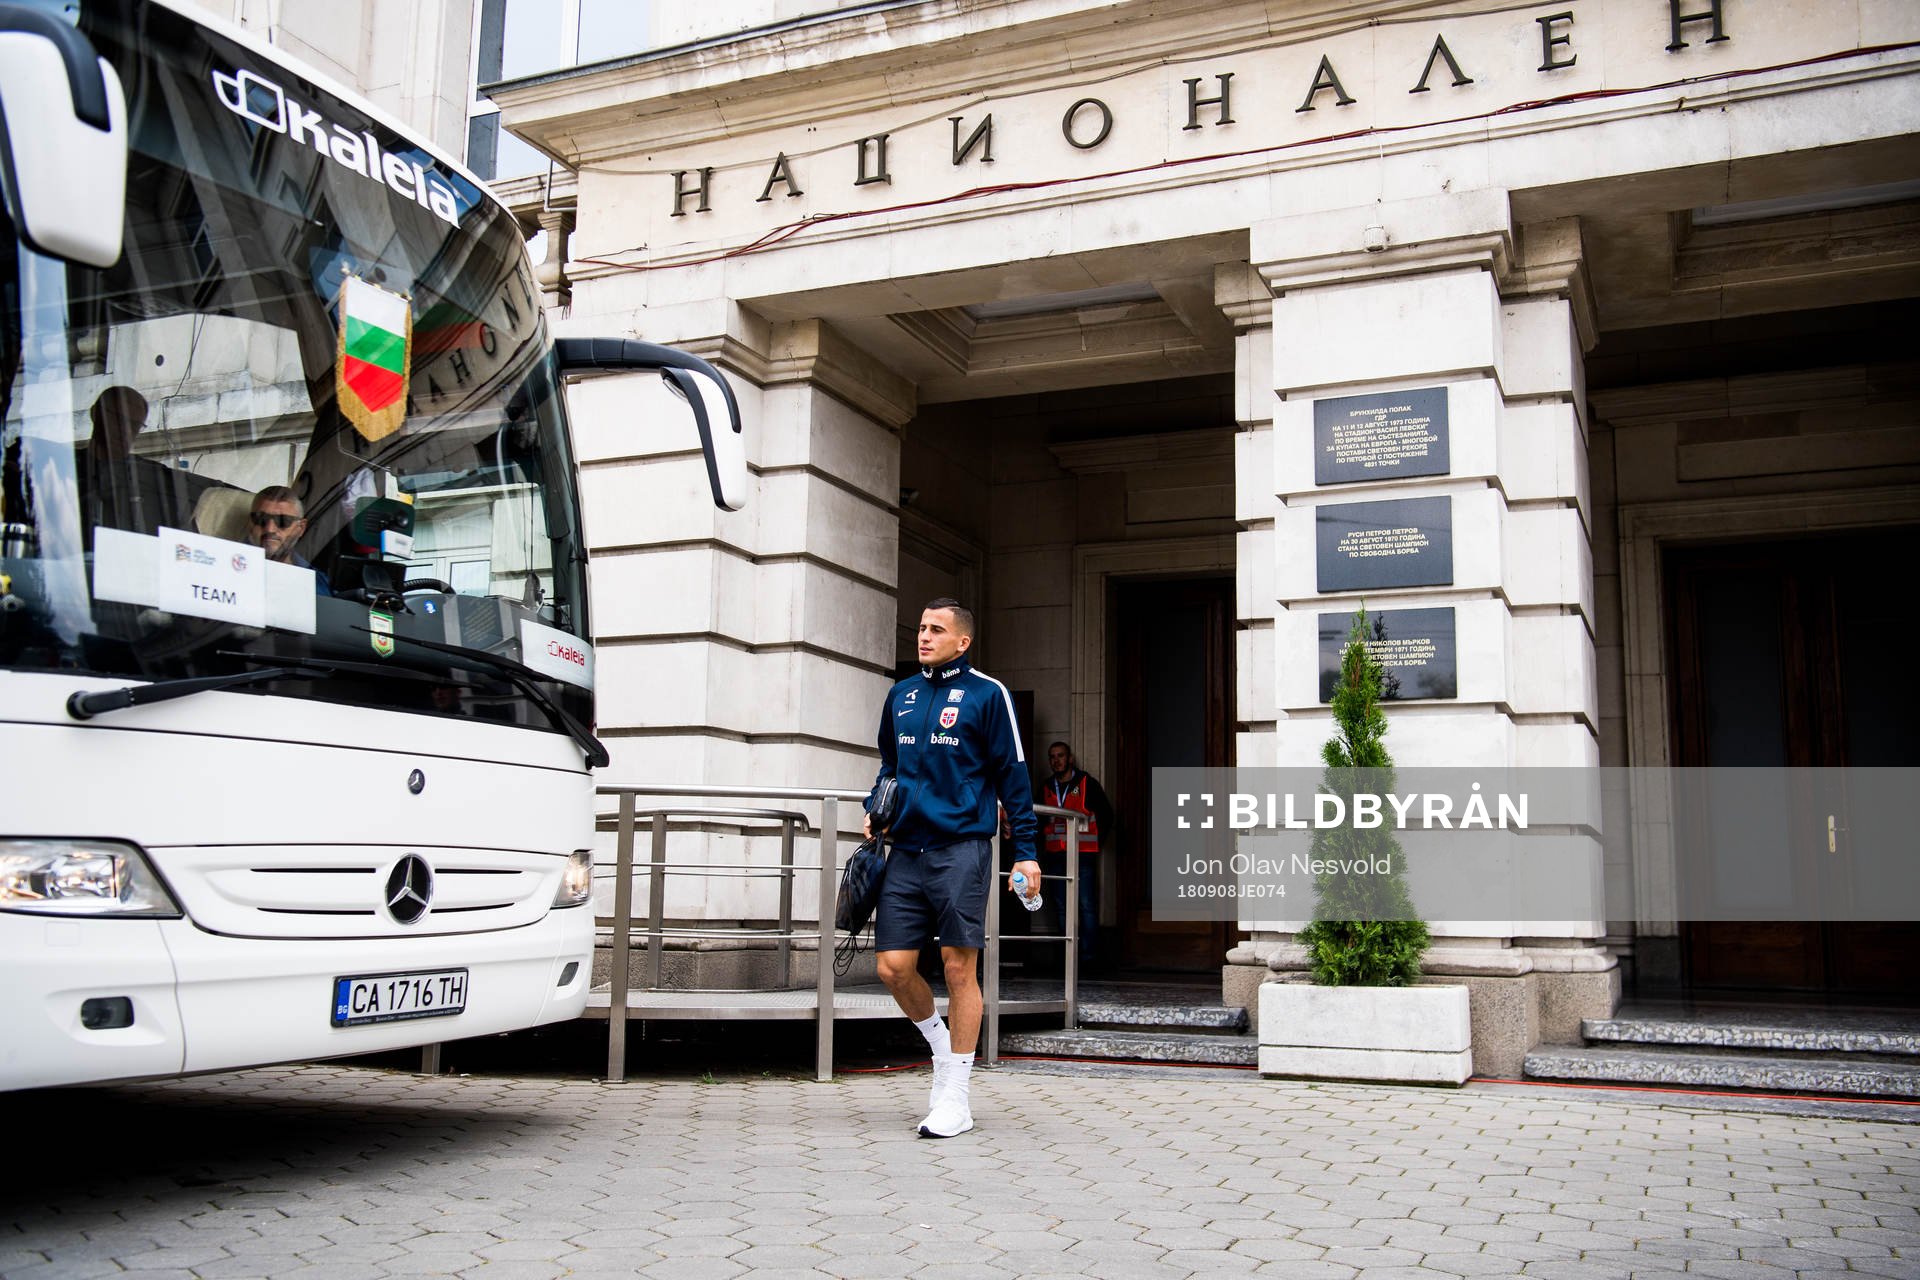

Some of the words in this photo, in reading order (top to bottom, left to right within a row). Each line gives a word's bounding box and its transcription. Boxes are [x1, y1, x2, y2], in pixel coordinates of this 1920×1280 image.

[1364, 420, 1389, 429] АВГУСТ
[1404, 416, 1430, 425] ГОДИНА
[1336, 443, 1360, 451] КУПАТА
[1371, 439, 1397, 447] ЕВРОПА
[1346, 436, 1367, 444] ВРЕМЕ
[1337, 449, 1366, 457] ПОСТАВИ
[1367, 446, 1400, 455] СВЕТОВЕН
[1383, 450, 1428, 460] ПОСТИЖЕНИЕ
[1378, 459, 1400, 467] ТОЧКИ
[1348, 530, 1365, 538] РУСИ
[1392, 527, 1418, 535] ПЕТРОВ
[1337, 544, 1359, 552] СТАНА
[1359, 542, 1393, 551] СВЕТОВЕН
[1394, 540, 1429, 548] ШАМПИОН
[1359, 549, 1396, 557] СВОБОДНА
[1397, 547, 1419, 555] БОРБА
[191, 584, 237, 605] TEAM
[1403, 638, 1430, 646] МЪРКОВ
[1404, 658, 1426, 666] БОРБА
[353, 983, 379, 1014] CA
[388, 978, 434, 1011] 1716
[439, 976, 464, 1005] TH
[337, 1005, 348, 1015] BG
